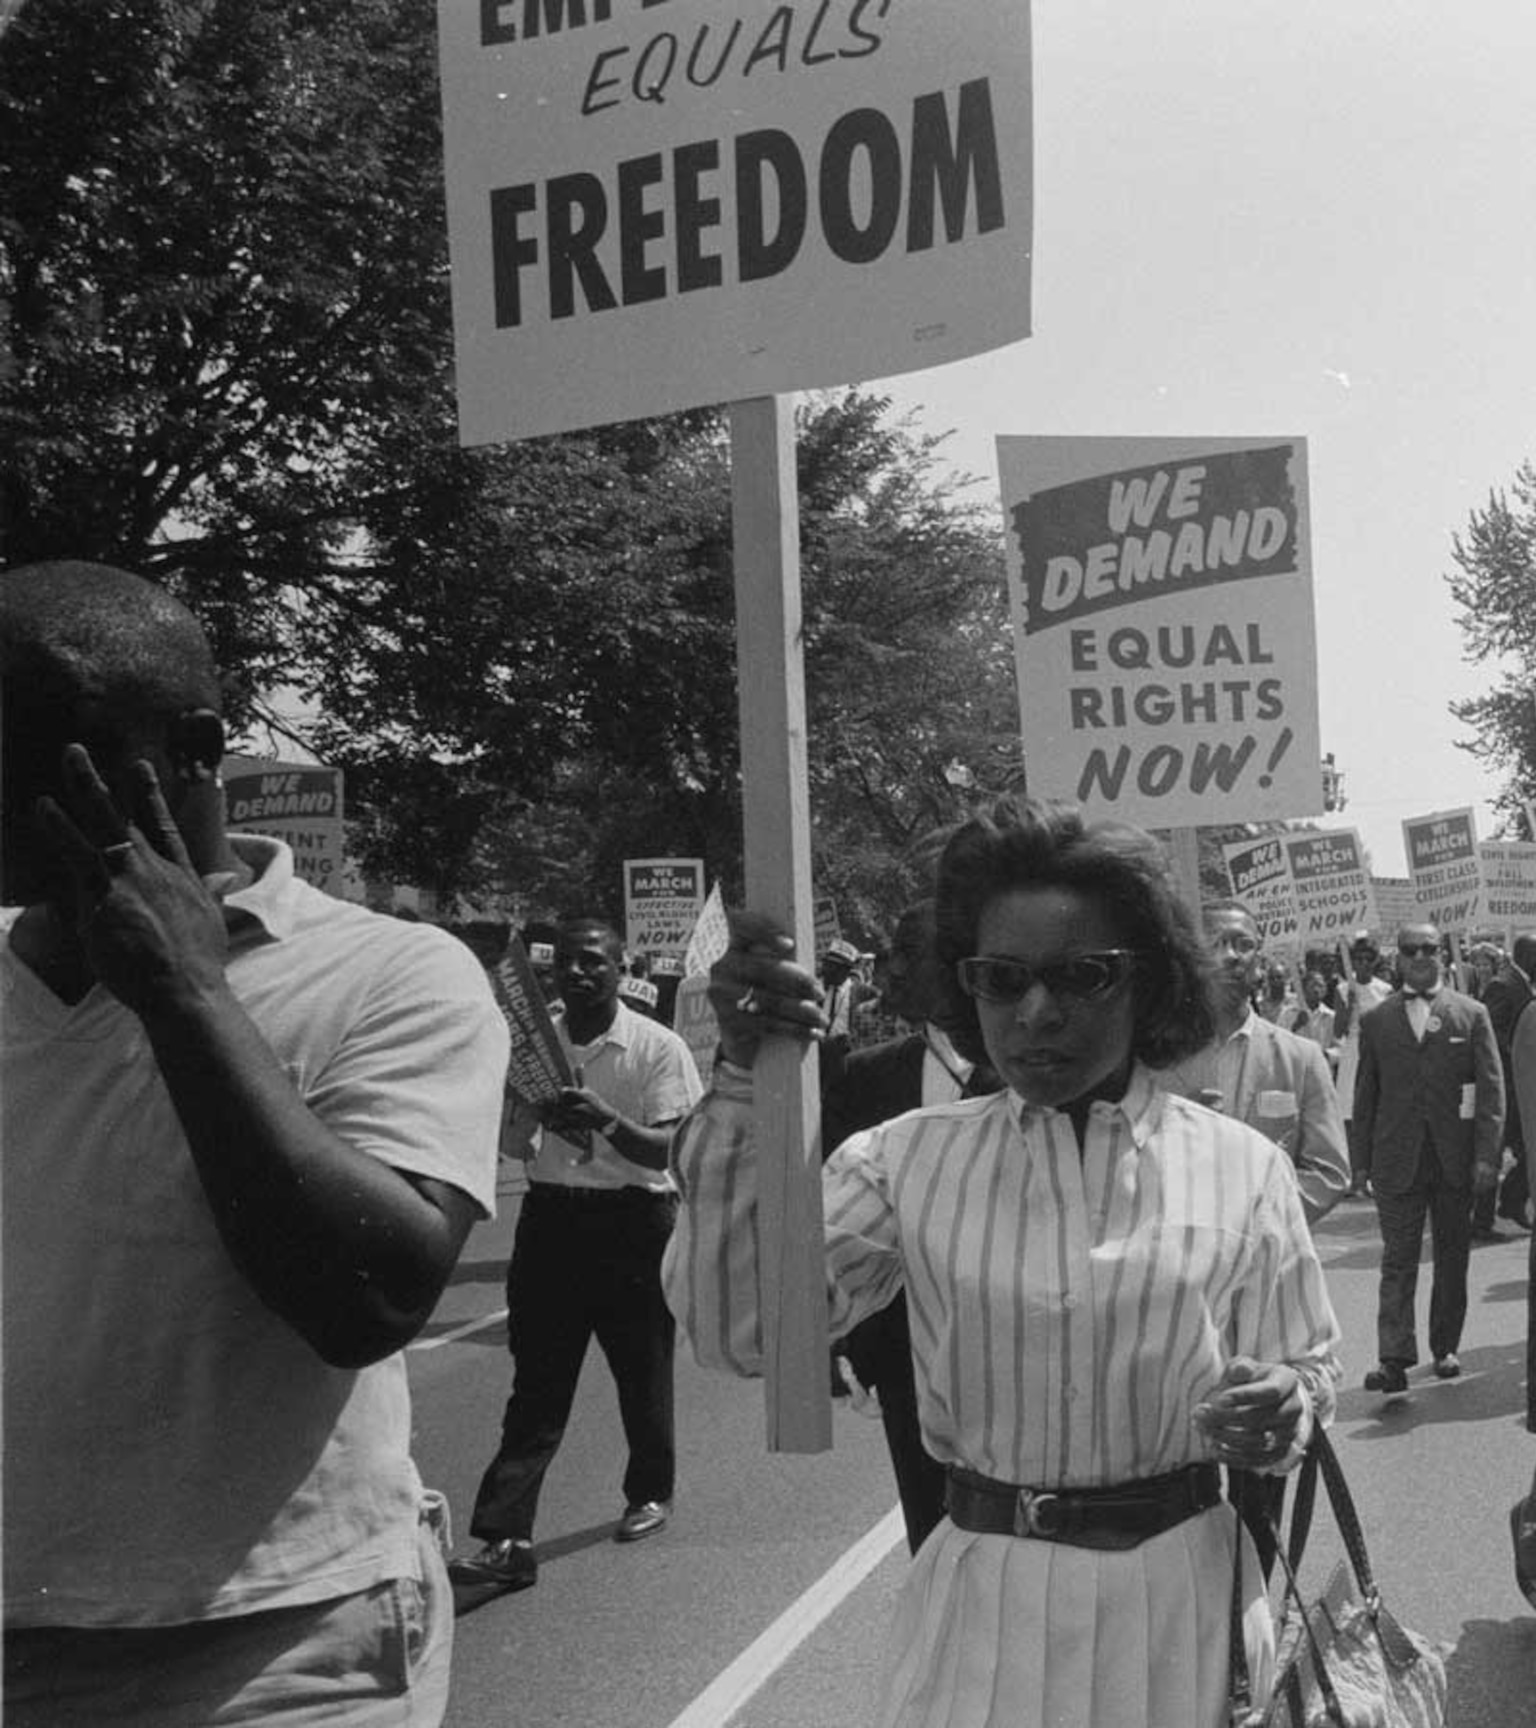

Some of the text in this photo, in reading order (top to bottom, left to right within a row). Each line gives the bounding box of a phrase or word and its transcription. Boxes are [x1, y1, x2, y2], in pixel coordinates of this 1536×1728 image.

[581, 0, 890, 115] EQUALS
[490, 76, 1005, 329] FREEDOM
[1108, 465, 1207, 534] WE
[1041, 506, 1288, 611] DEMAND
[1070, 622, 1274, 672] EQUAL
[1069, 678, 1284, 730] RIGHTS
[1077, 726, 1293, 801] NOW!
[260, 773, 302, 796] WE
[231, 790, 334, 822] DEMAND
[1431, 822, 1449, 835] WE
[1251, 842, 1279, 865] WE
[1310, 839, 1333, 851] WE
[1415, 831, 1469, 857] MARCH
[1295, 848, 1354, 869] MARCH
[634, 876, 693, 892] MARCH
[652, 867, 674, 877] WE
[1238, 858, 1286, 889] DEMA
[1415, 861, 1479, 887] FIRST CLASS
[1272, 884, 1291, 896] EN
[1298, 889, 1368, 912] SCHOOLS
[1309, 905, 1367, 931] NOW!
[1429, 895, 1479, 926] NOW!
[636, 928, 694, 945] NOW!
[1257, 916, 1298, 938] NOW
[498, 957, 535, 1022] MARCH
[521, 1053, 560, 1103] FREEDO
